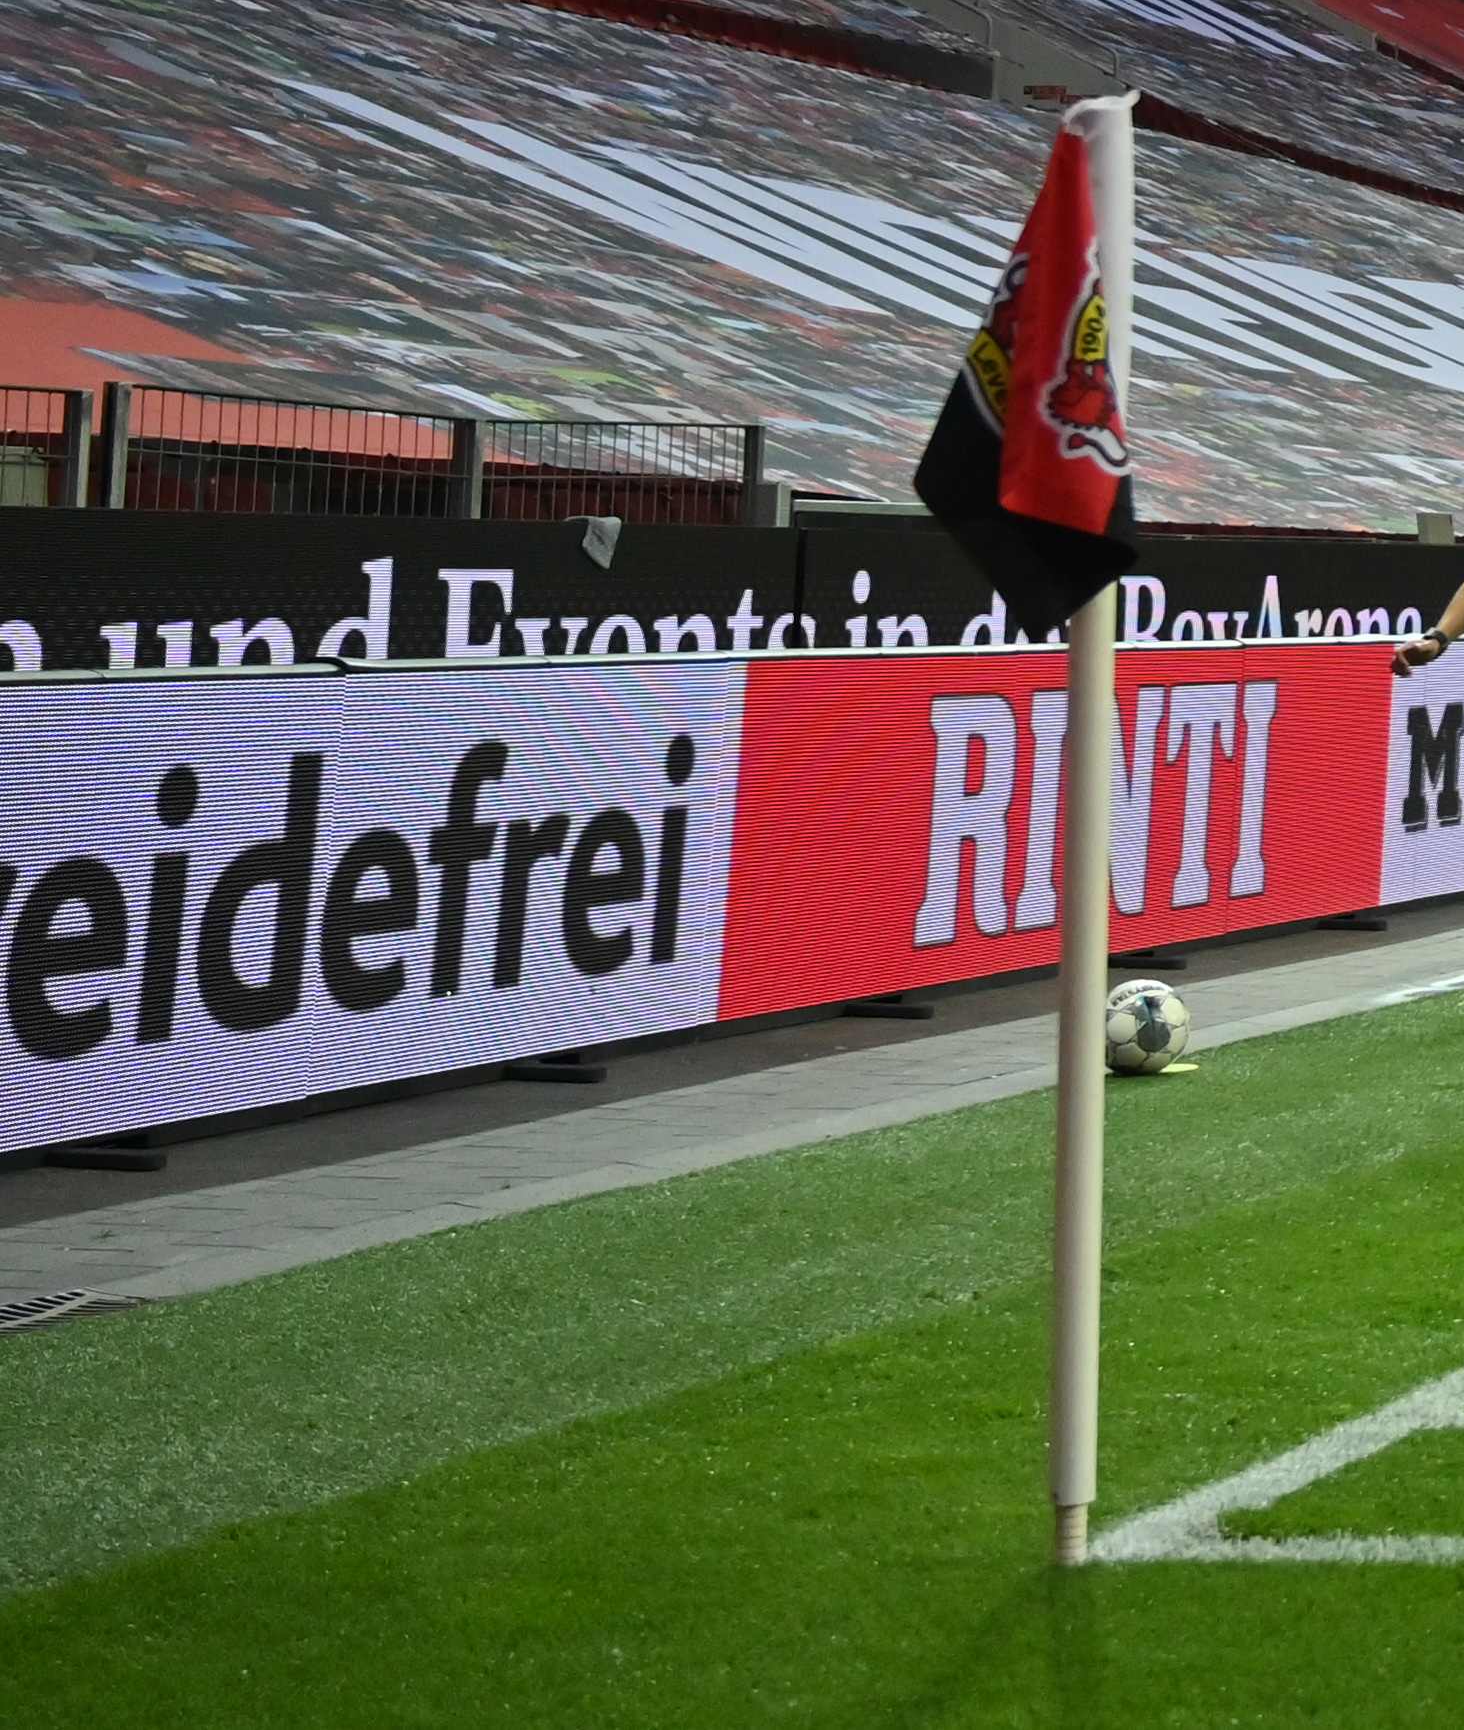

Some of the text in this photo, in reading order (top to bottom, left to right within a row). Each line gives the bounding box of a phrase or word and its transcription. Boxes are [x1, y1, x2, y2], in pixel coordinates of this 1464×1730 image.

[100, 556, 394, 666] und
[438, 568, 815, 658] Events
[847, 570, 930, 648] in
[913, 678, 1278, 950] RINTI
